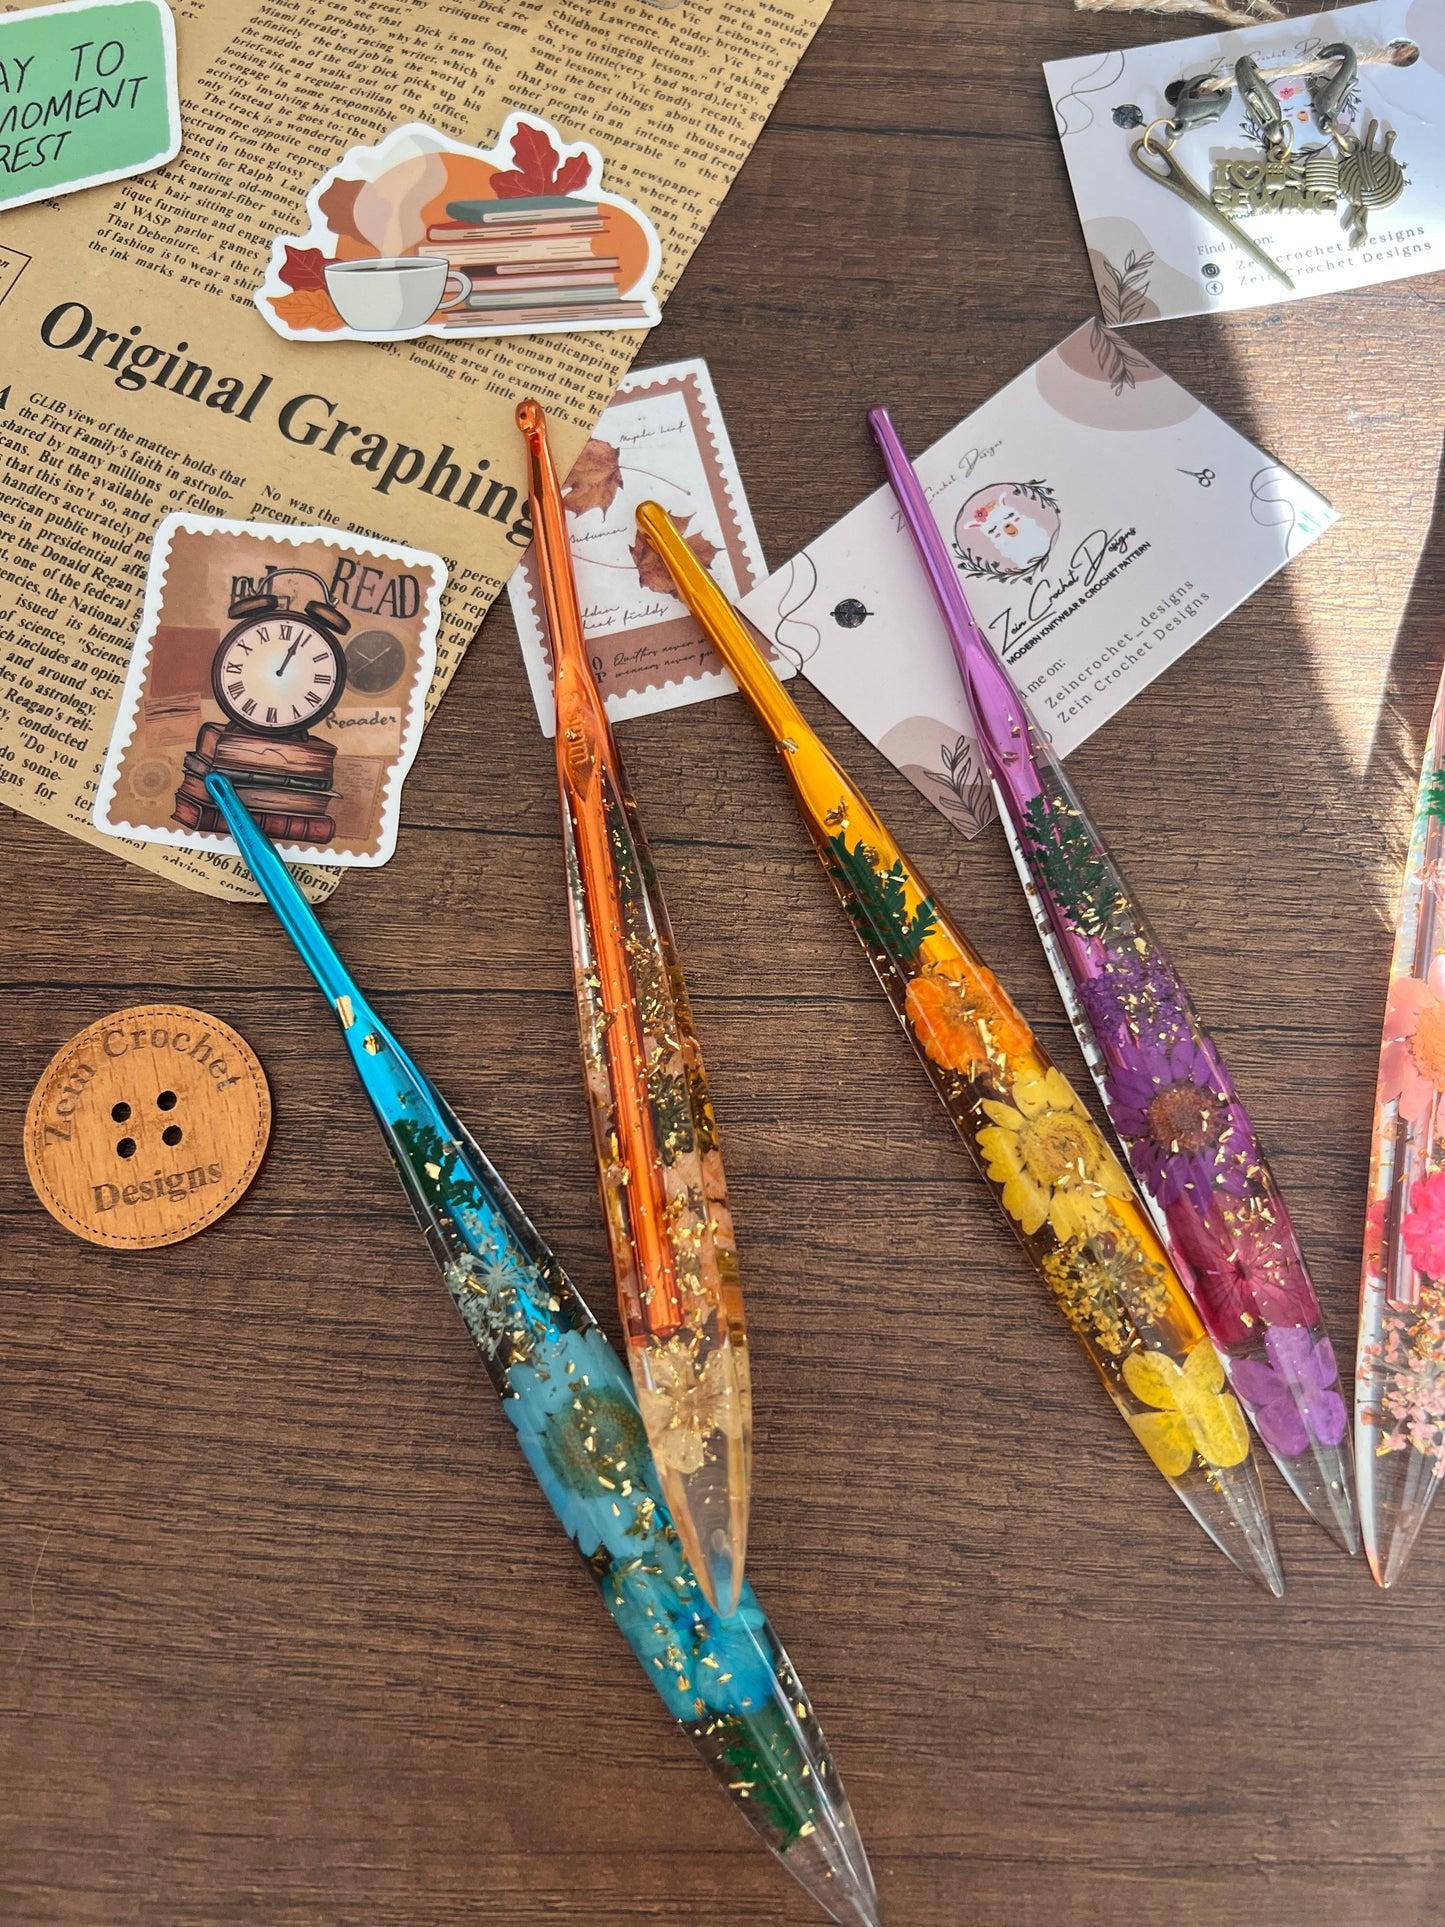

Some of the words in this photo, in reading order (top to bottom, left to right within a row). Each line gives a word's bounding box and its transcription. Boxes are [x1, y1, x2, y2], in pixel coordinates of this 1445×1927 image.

[70, 40, 124, 82] TO
[231, 35, 285, 59] briefcase
[289, 56, 315, 70] and
[319, 66, 353, 80] walks
[357, 76, 378, 87] out
[382, 83, 400, 92] of
[401, 87, 422, 101] the
[431, 101, 469, 125] office,
[203, 90, 226, 106] The
[227, 101, 261, 121] track
[262, 114, 274, 124] is
[274, 119, 284, 127] a
[286, 122, 349, 149] wonderful
[507, 83, 543, 100] other
[545, 97, 590, 117] people
[591, 109, 605, 123] in
[607, 118, 624, 130] an
[634, 125, 680, 151] intense
[681, 146, 709, 162] and
[534, 60, 558, 78] But
[563, 73, 585, 86] the
[586, 79, 613, 96] best
[614, 90, 654, 112] things
[664, 109, 702, 128] about
[704, 122, 725, 138] the
[499, 95, 546, 116] mental
[549, 112, 586, 132] effort
[587, 126, 663, 160] comparable
[673, 157, 687, 169] to
[697, 166, 719, 181] the
[106, 212, 135, 231] That
[136, 223, 200, 255] Debenture.
[206, 250, 225, 264] At
[229, 258, 250, 273] the
[112, 200, 127, 211] al
[132, 204, 172, 227] WASP
[172, 223, 215, 242] parlor
[218, 238, 260, 260] games
[1197, 243, 1226, 256] Find
[1362, 241, 1433, 264] Designs
[87, 240, 108, 254] the
[108, 246, 130, 262] ink
[134, 257, 175, 278] marks
[179, 274, 201, 289] are
[203, 282, 224, 297] the
[408, 351, 457, 380] looking
[458, 370, 480, 386] for
[483, 380, 516, 400] little
[459, 357, 489, 374] area
[491, 368, 506, 380] to
[507, 375, 562, 401] examine
[563, 395, 586, 410] the
[476, 346, 494, 358] of
[492, 352, 514, 367] the
[515, 362, 558, 382] crowd
[558, 376, 586, 394] that
[17, 406, 39, 422] the
[39, 413, 73, 435] First
[72, 426, 129, 458] Family's
[129, 449, 163, 473] faith
[164, 467, 180, 481] in
[181, 475, 234, 500] astrolo-
[28, 391, 68, 414] GLIB
[67, 408, 98, 426] view
[97, 421, 116, 434] of
[112, 426, 135, 442] the
[134, 435, 182, 461] matter
[180, 452, 218, 477] holds
[218, 468, 247, 488] that
[40, 301, 274, 424] Original
[278, 393, 534, 548] Graphing
[0, 418, 47, 443] shared
[45, 433, 66, 451] by
[65, 444, 106, 470] many
[106, 462, 163, 492] millions
[168, 488, 188, 502] of
[186, 493, 228, 520] fellow
[259, 483, 282, 502] No
[288, 497, 316, 515] was
[318, 507, 341, 525] the
[328, 556, 421, 620] READ
[988, 607, 1050, 656] Zein
[1028, 569, 1080, 622] Crochet
[1070, 527, 1137, 587] Designs
[1006, 634, 1043, 666] MODERN
[1041, 602, 1081, 638] KNITWEAR
[1084, 566, 1120, 599] CROCHET
[1119, 541, 1152, 572] PATTERN
[0, 609, 17, 622] of
[17, 617, 66, 647] science,
[77, 636, 131, 669] "Science
[15, 636, 71, 665] includes
[70, 658, 89, 672] an
[89, 666, 126, 685] opin-
[1044, 580, 1194, 709] Zeincrochet_designs
[1057, 693, 1093, 724] Zein
[1094, 641, 1153, 692] Crochet
[1153, 591, 1210, 641] Designs
[1027, 674, 1047, 694] me
[1047, 658, 1067, 677] on:
[196, 846, 230, 871] 1966
[43, 1063, 97, 1147] Zein
[102, 1028, 241, 1093] Crochet
[91, 1162, 222, 1214] Designs
